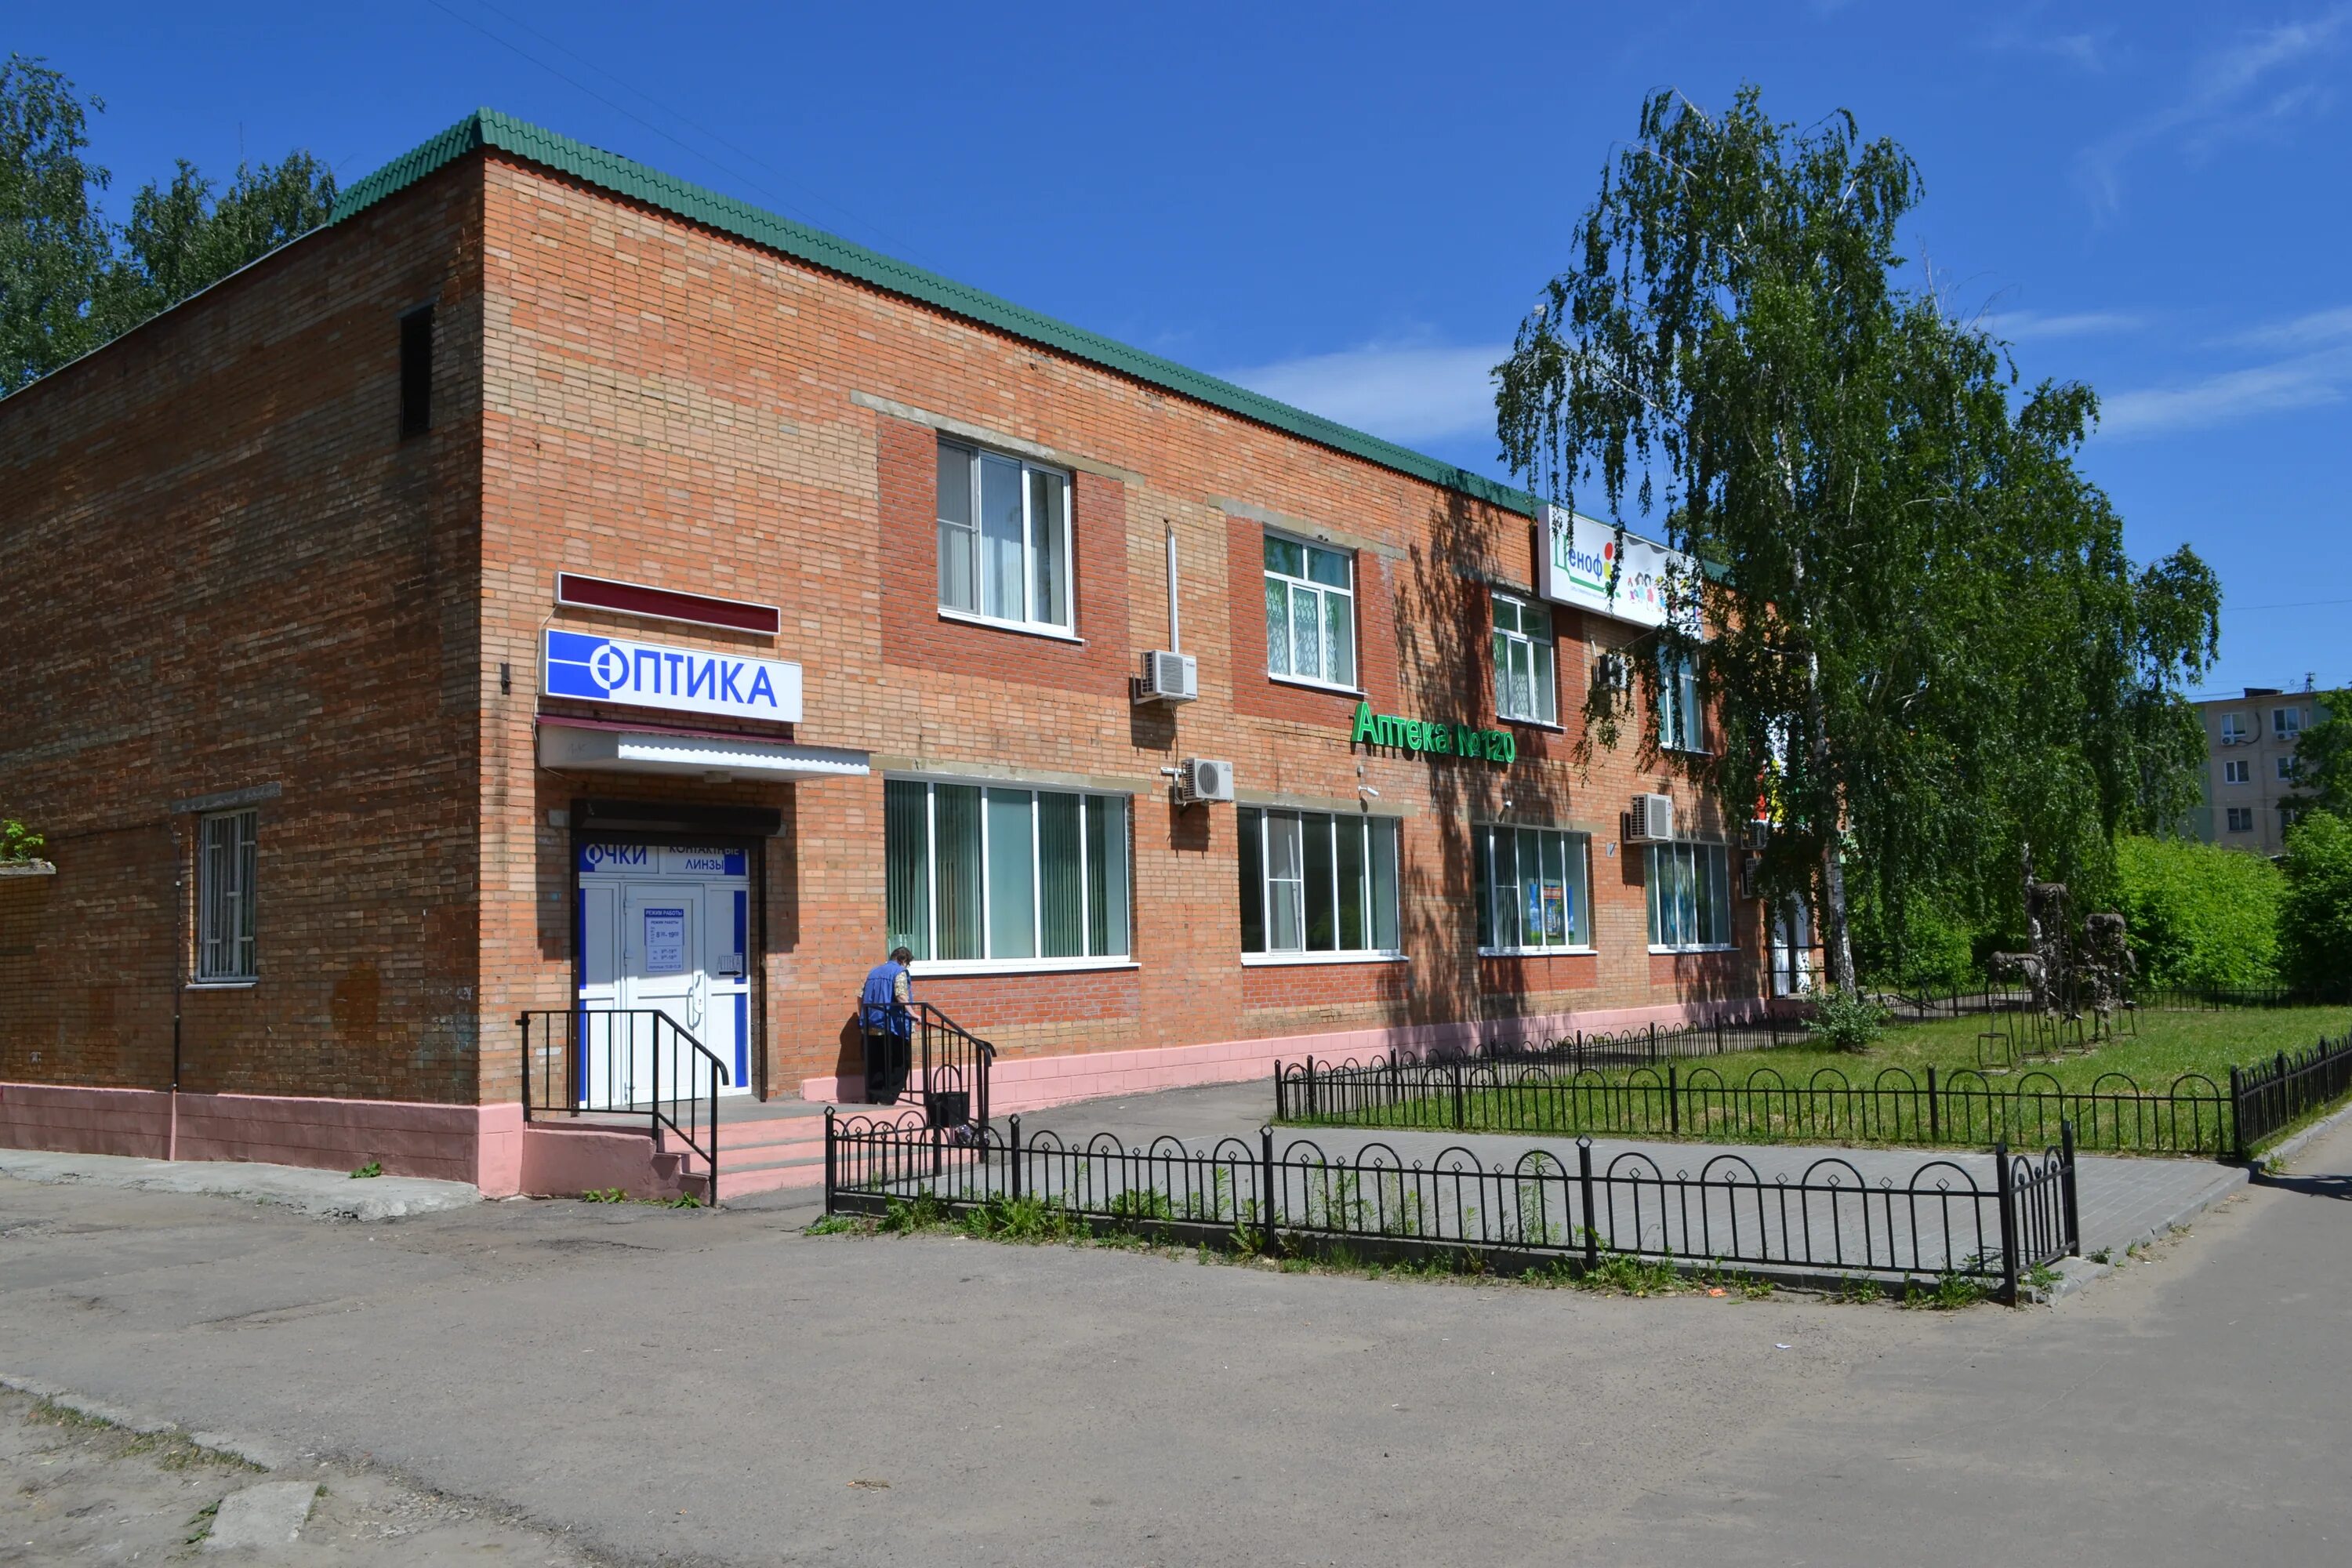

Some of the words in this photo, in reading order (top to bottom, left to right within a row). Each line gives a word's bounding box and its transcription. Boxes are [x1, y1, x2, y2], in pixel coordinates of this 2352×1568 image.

[590, 644, 778, 707] ОПТИКА
[1352, 702, 1449, 753] Аптека
[586, 844, 647, 865] ОЧКИ
[685, 858, 724, 870] ЛИНЗЫ
